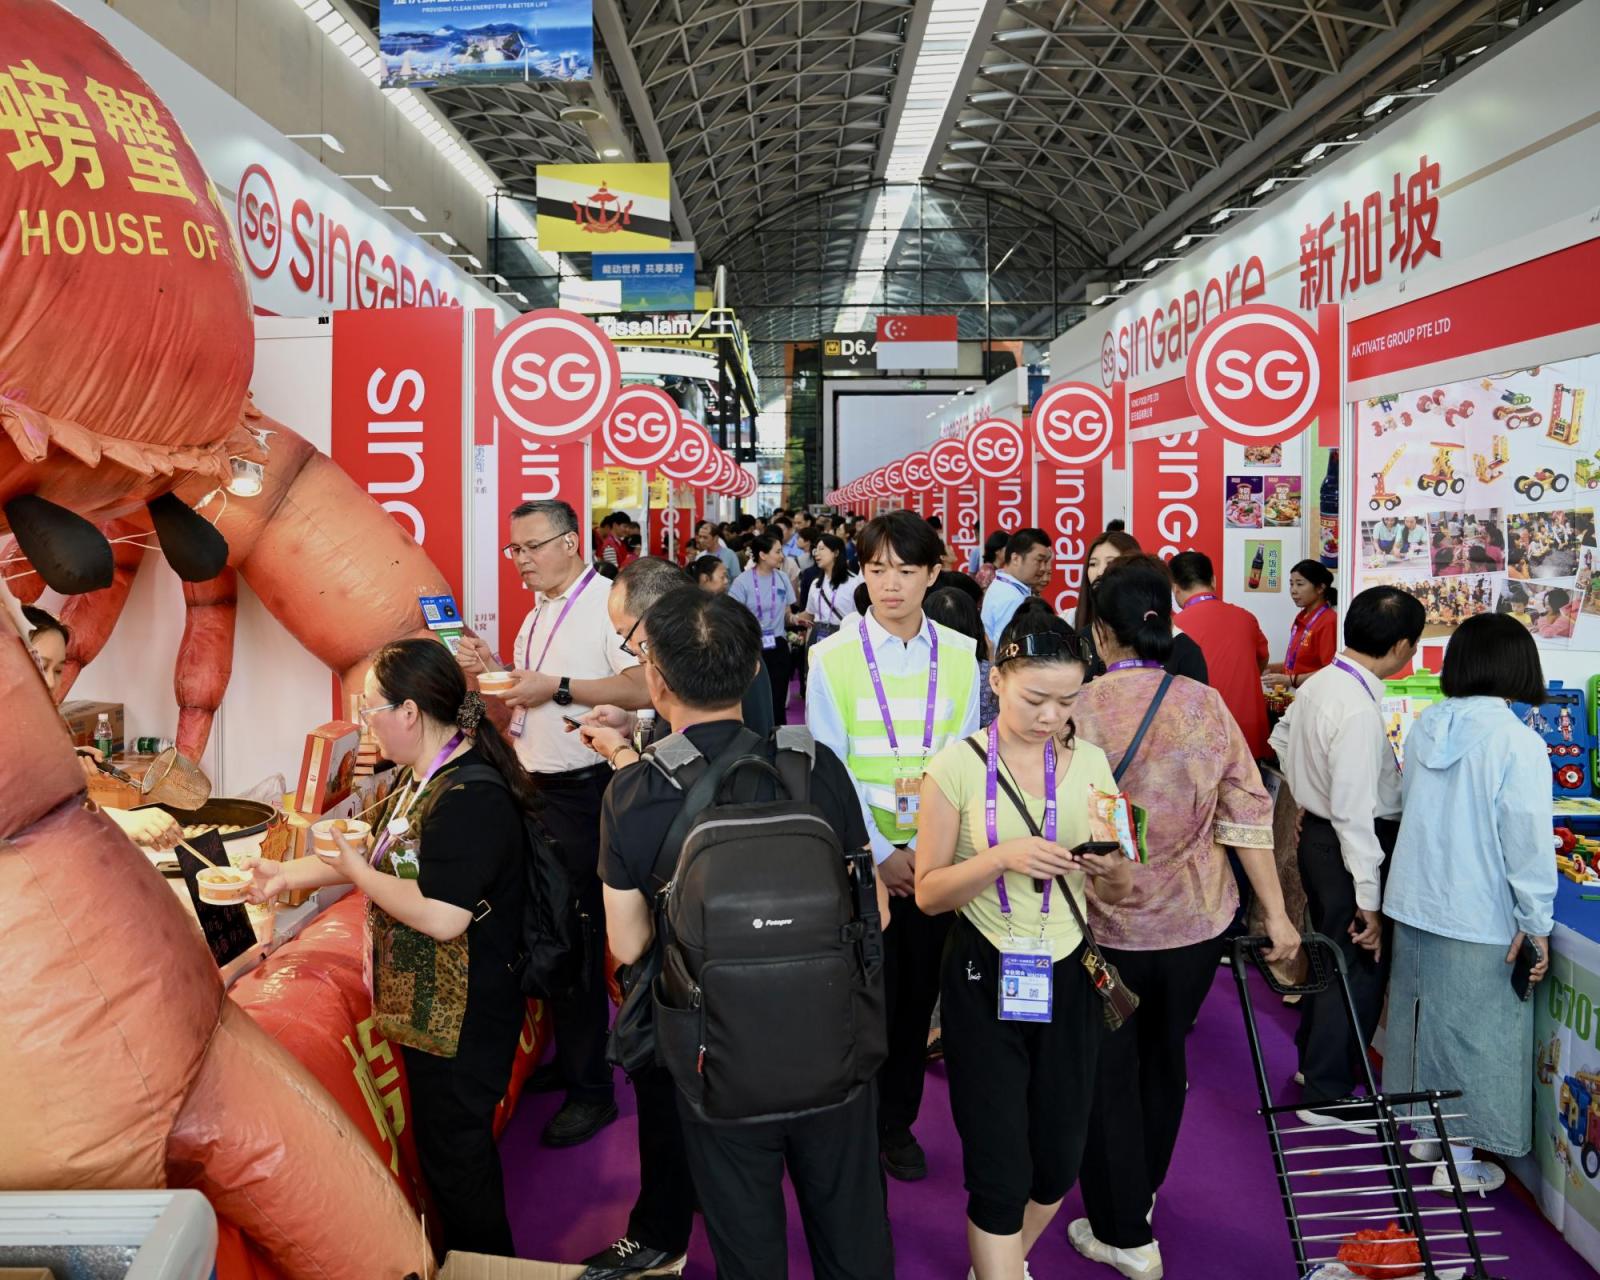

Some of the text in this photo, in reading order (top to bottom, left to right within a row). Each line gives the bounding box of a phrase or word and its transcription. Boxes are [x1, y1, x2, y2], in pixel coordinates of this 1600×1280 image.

[18, 209, 169, 256] HOUSE
[182, 220, 219, 261] OF
[244, 192, 276, 249] SG
[1299, 155, 1441, 311] 新加坡
[602, 263, 684, 274] 能动世界 共享美好
[1351, 317, 1451, 358] AKTIVATE GROUP PTE LTD
[510, 352, 596, 401] SG
[1214, 349, 1304, 400] SG
[613, 411, 668, 443] SG
[1048, 409, 1103, 442] SG
[936, 454, 968, 473] SG
[976, 437, 1017, 461] SG
[1268, 549, 1278, 588] 鸡饭老抽
